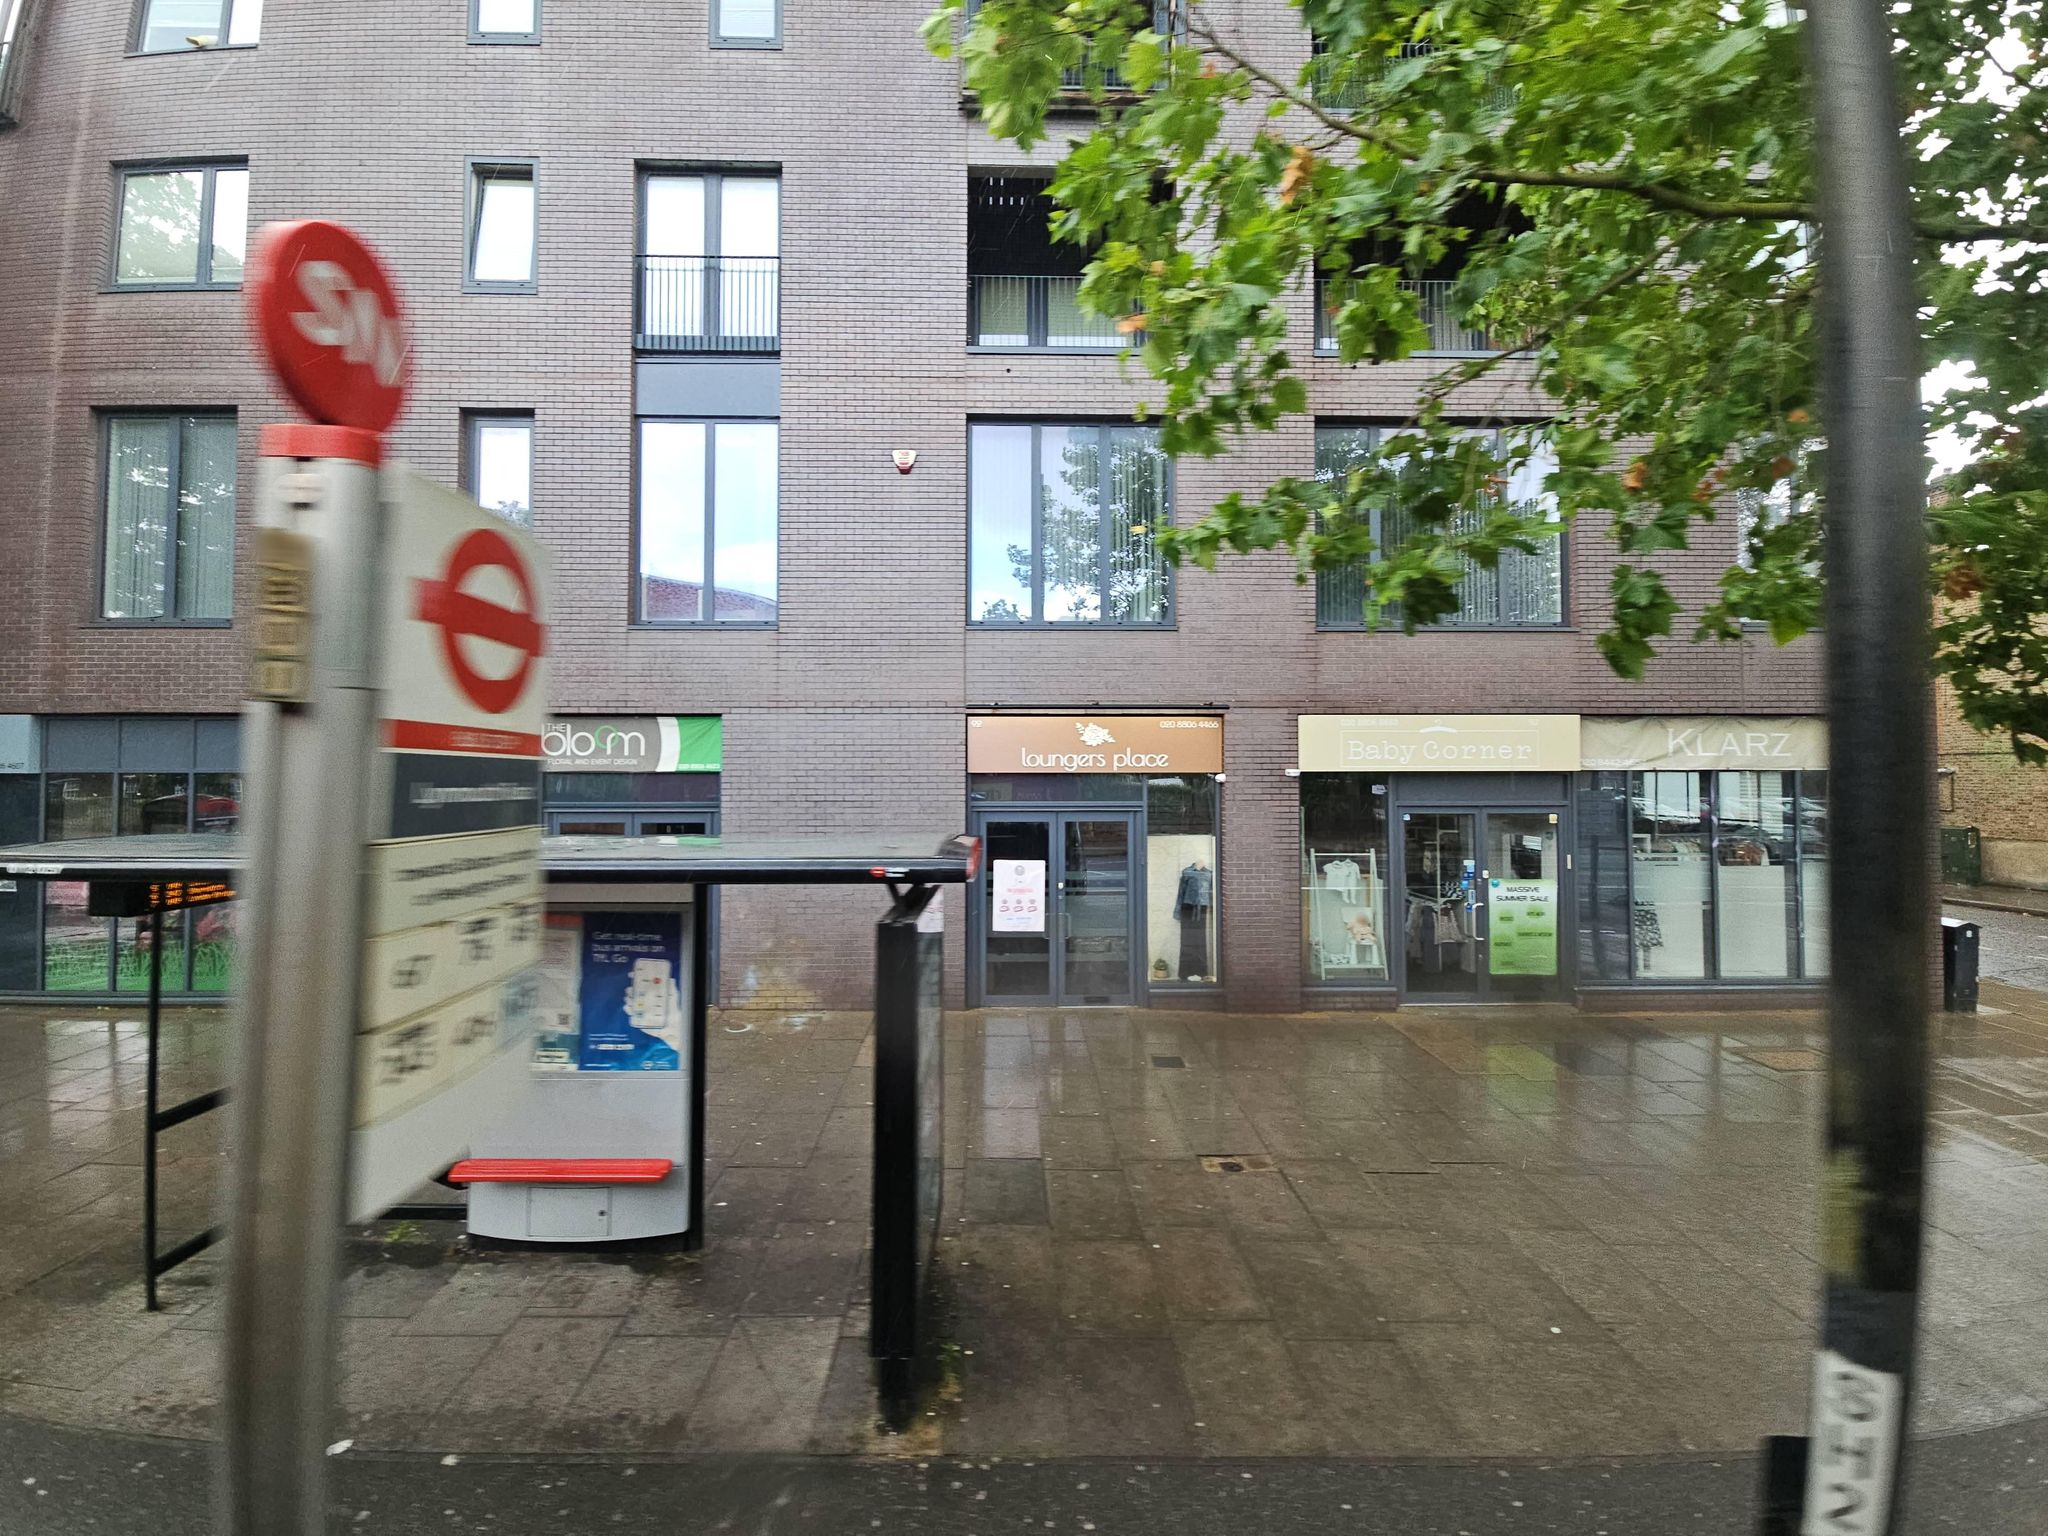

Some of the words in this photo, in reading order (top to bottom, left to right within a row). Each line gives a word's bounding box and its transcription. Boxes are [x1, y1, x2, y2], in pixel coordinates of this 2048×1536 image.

[547, 723, 567, 733] THE
[1159, 720, 1176, 729] 020
[541, 723, 646, 757] bloom
[1666, 728, 1793, 757] KLARZ
[1021, 747, 1106, 772] loungers
[1113, 747, 1169, 771] place
[1347, 740, 1417, 764] Baby
[1423, 740, 1532, 760] Corner
[547, 758, 574, 766] FLORAL
[574, 758, 590, 766] AND
[591, 758, 612, 766] EVENT
[613, 758, 638, 767] DESIGN
[592, 931, 612, 941] Get
